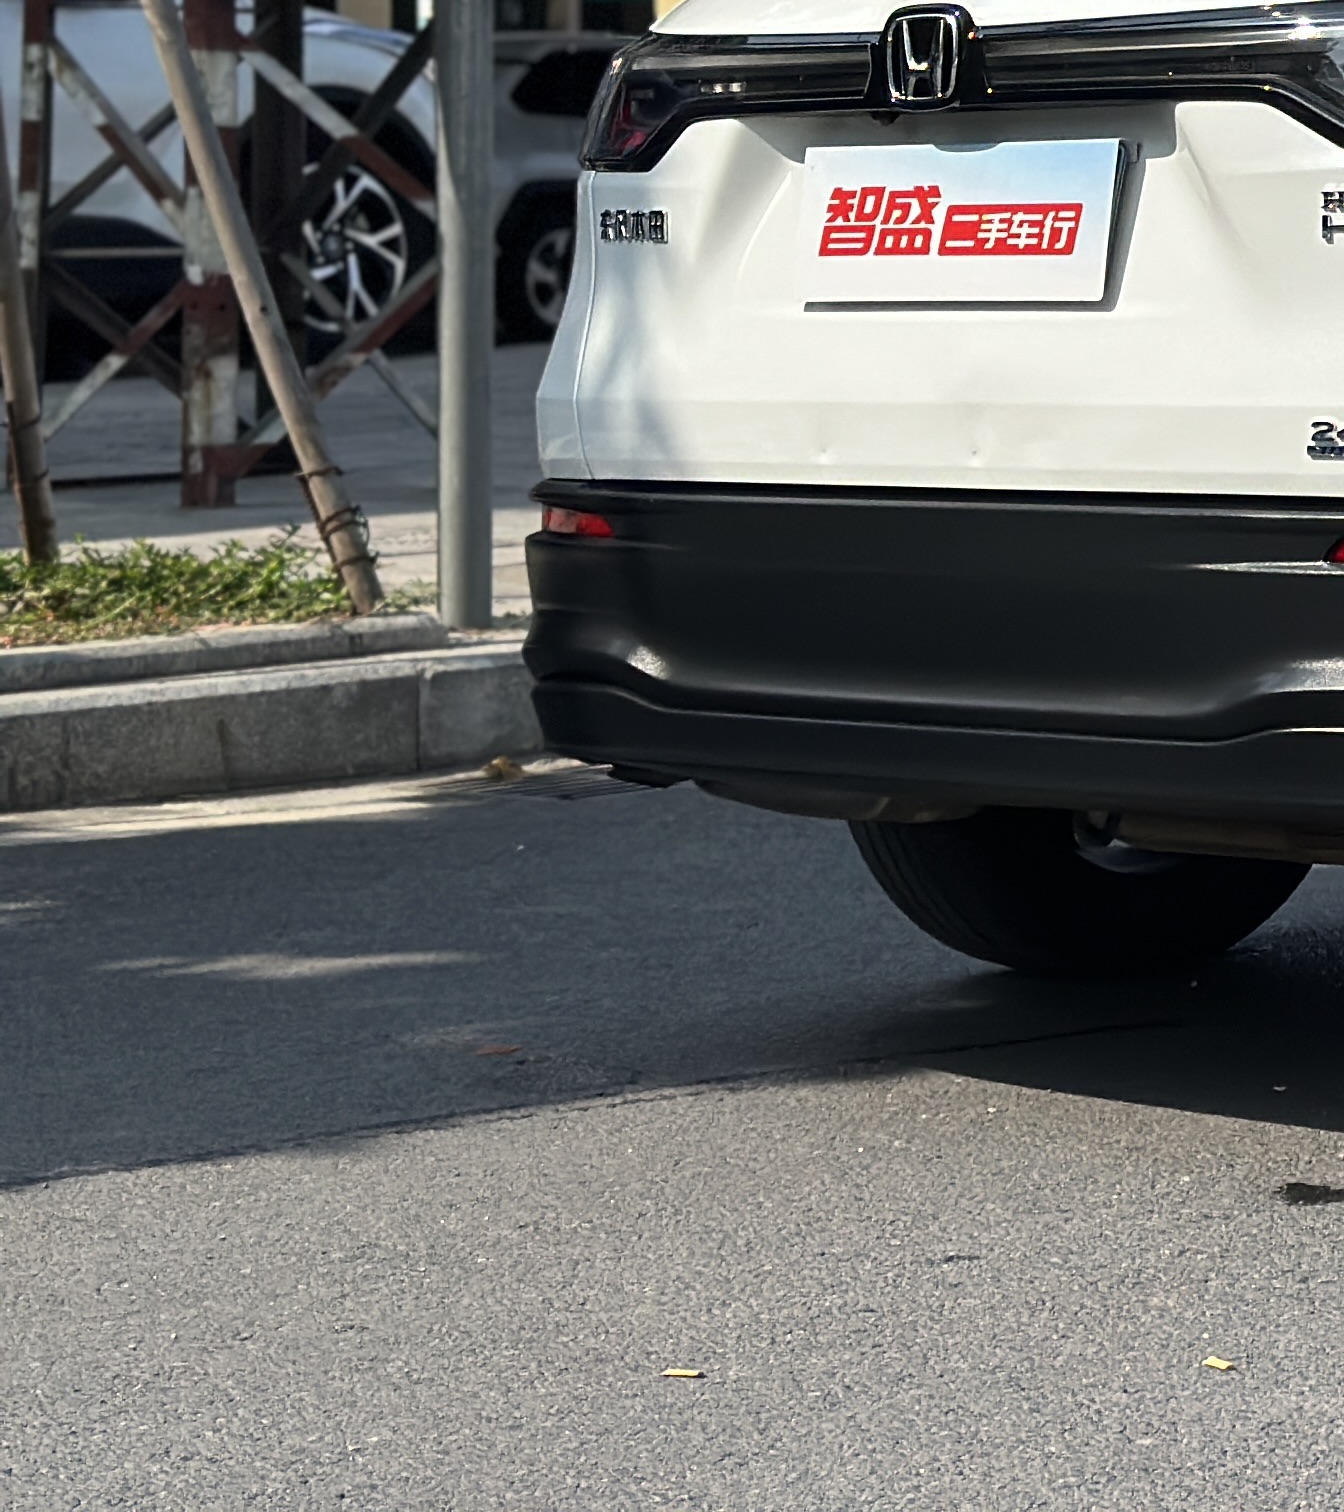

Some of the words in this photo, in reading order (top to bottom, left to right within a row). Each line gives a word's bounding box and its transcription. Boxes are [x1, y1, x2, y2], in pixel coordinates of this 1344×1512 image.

[817, 185, 942, 256] 智盛
[945, 210, 1076, 250] 二手车行
